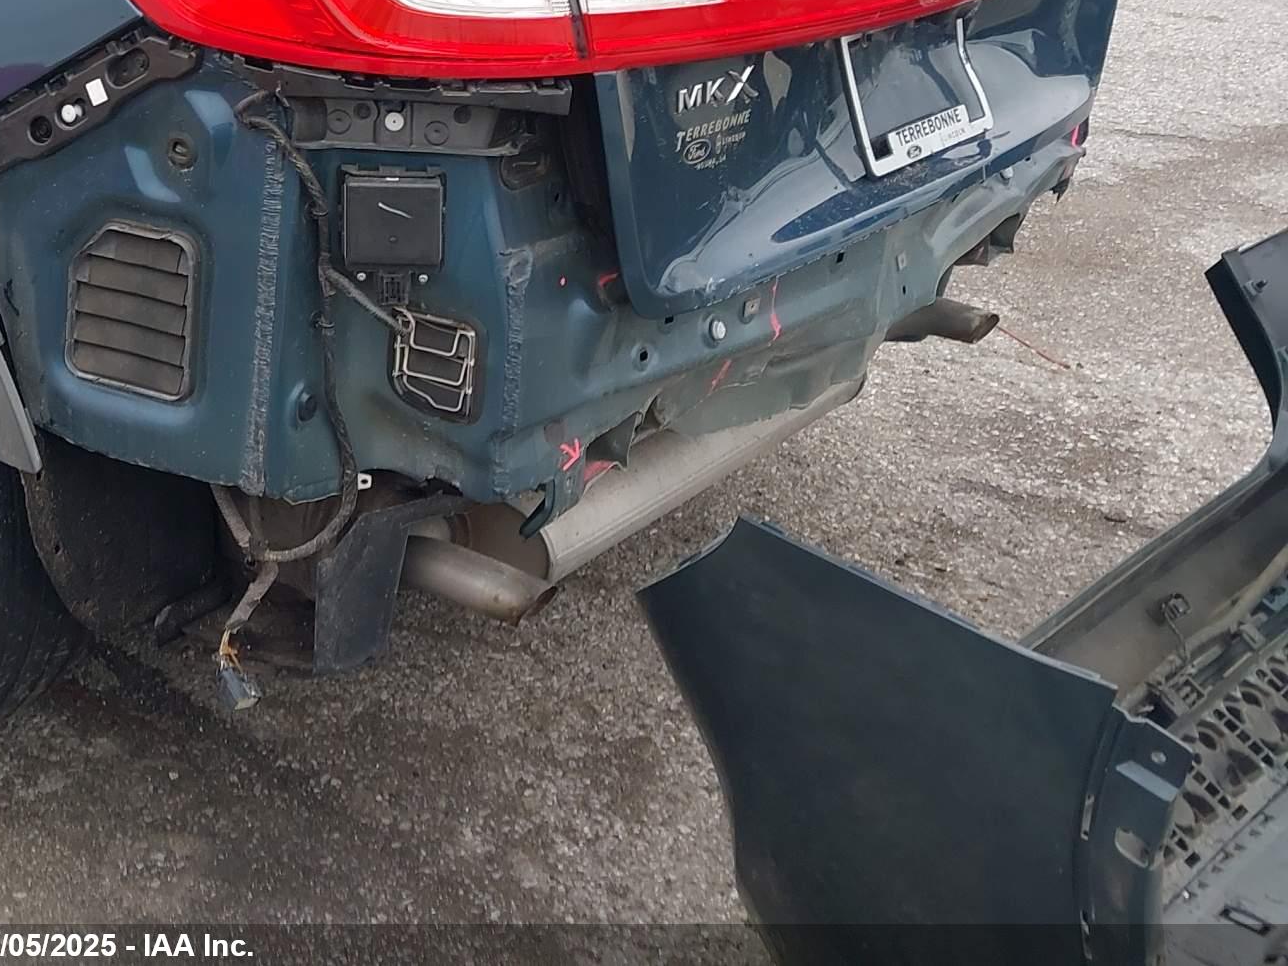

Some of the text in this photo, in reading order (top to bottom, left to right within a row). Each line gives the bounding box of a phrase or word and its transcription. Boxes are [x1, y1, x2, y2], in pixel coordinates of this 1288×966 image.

[677, 65, 759, 114] MKX
[675, 109, 752, 153] TERREBONNE
[895, 108, 962, 147] TERREBONNE
